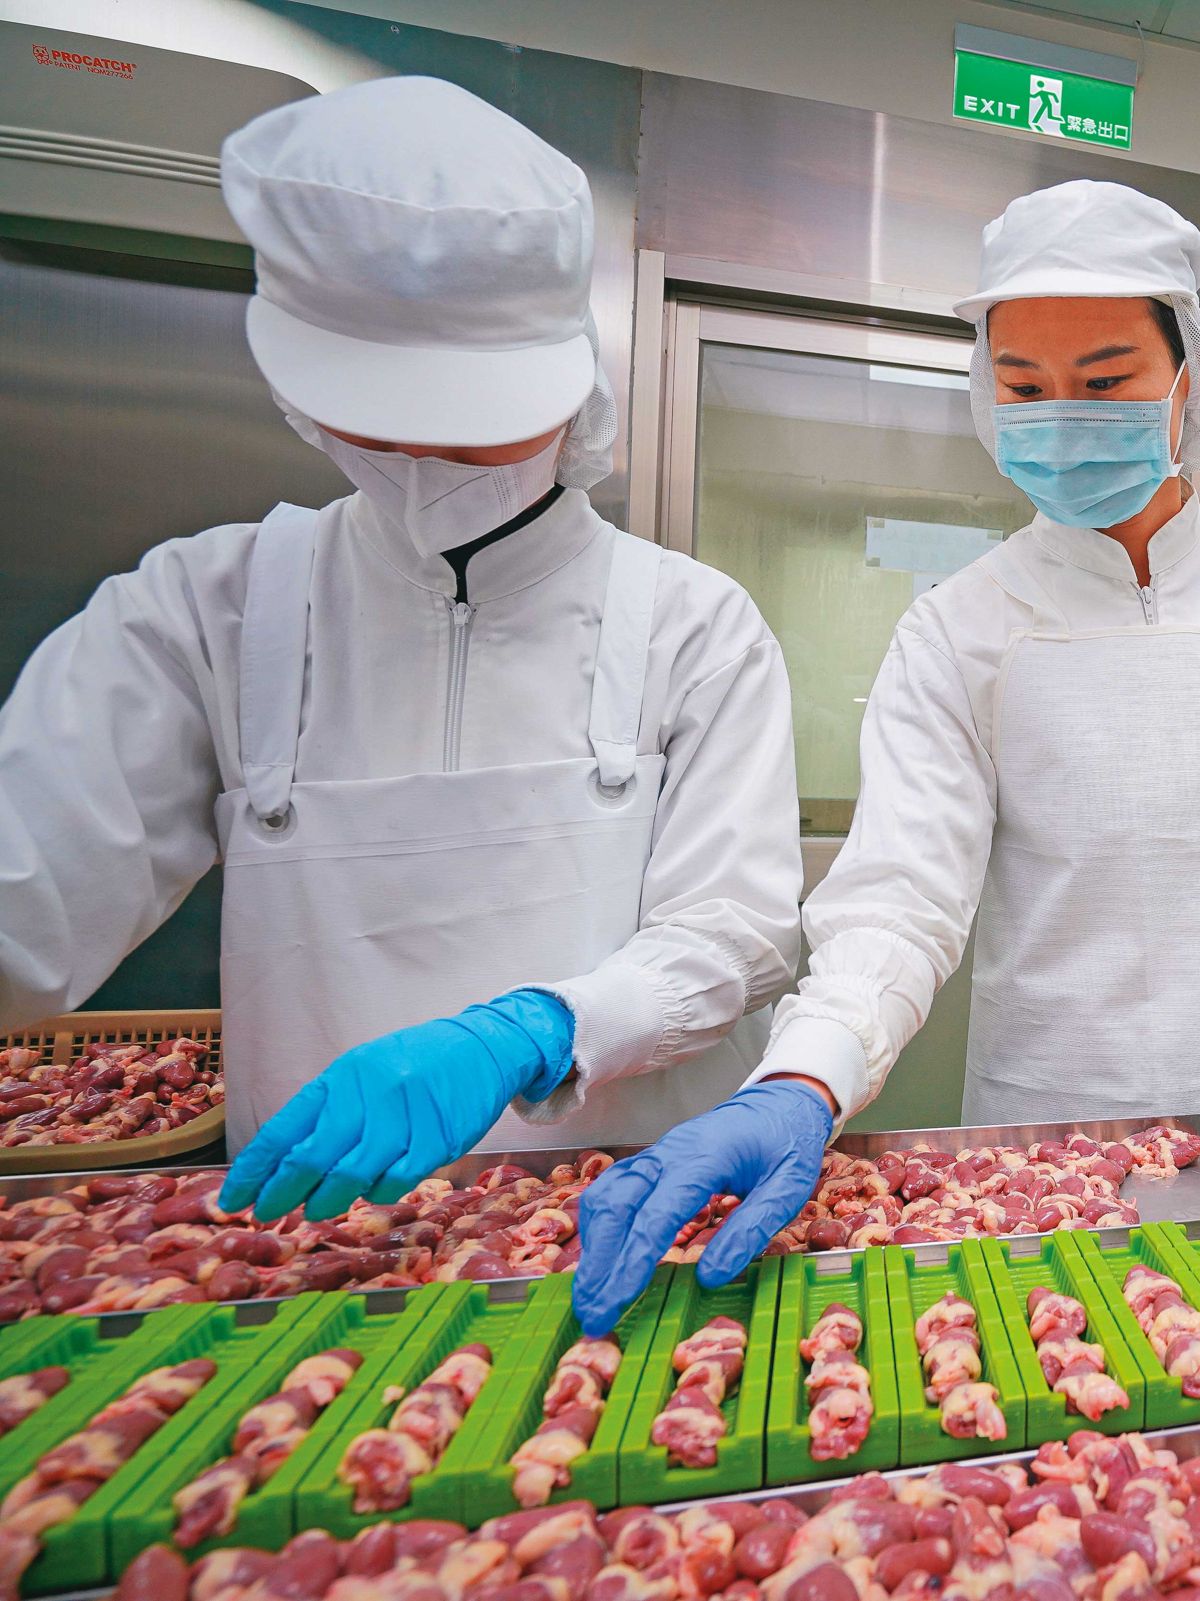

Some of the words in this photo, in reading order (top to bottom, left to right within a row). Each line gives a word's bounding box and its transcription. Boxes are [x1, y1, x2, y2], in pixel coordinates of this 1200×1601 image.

[51, 49, 134, 73] PROCATCH
[54, 61, 81, 71] PATENT
[963, 95, 1020, 120] EXIT
[1067, 115, 1129, 142] 緊急出口
